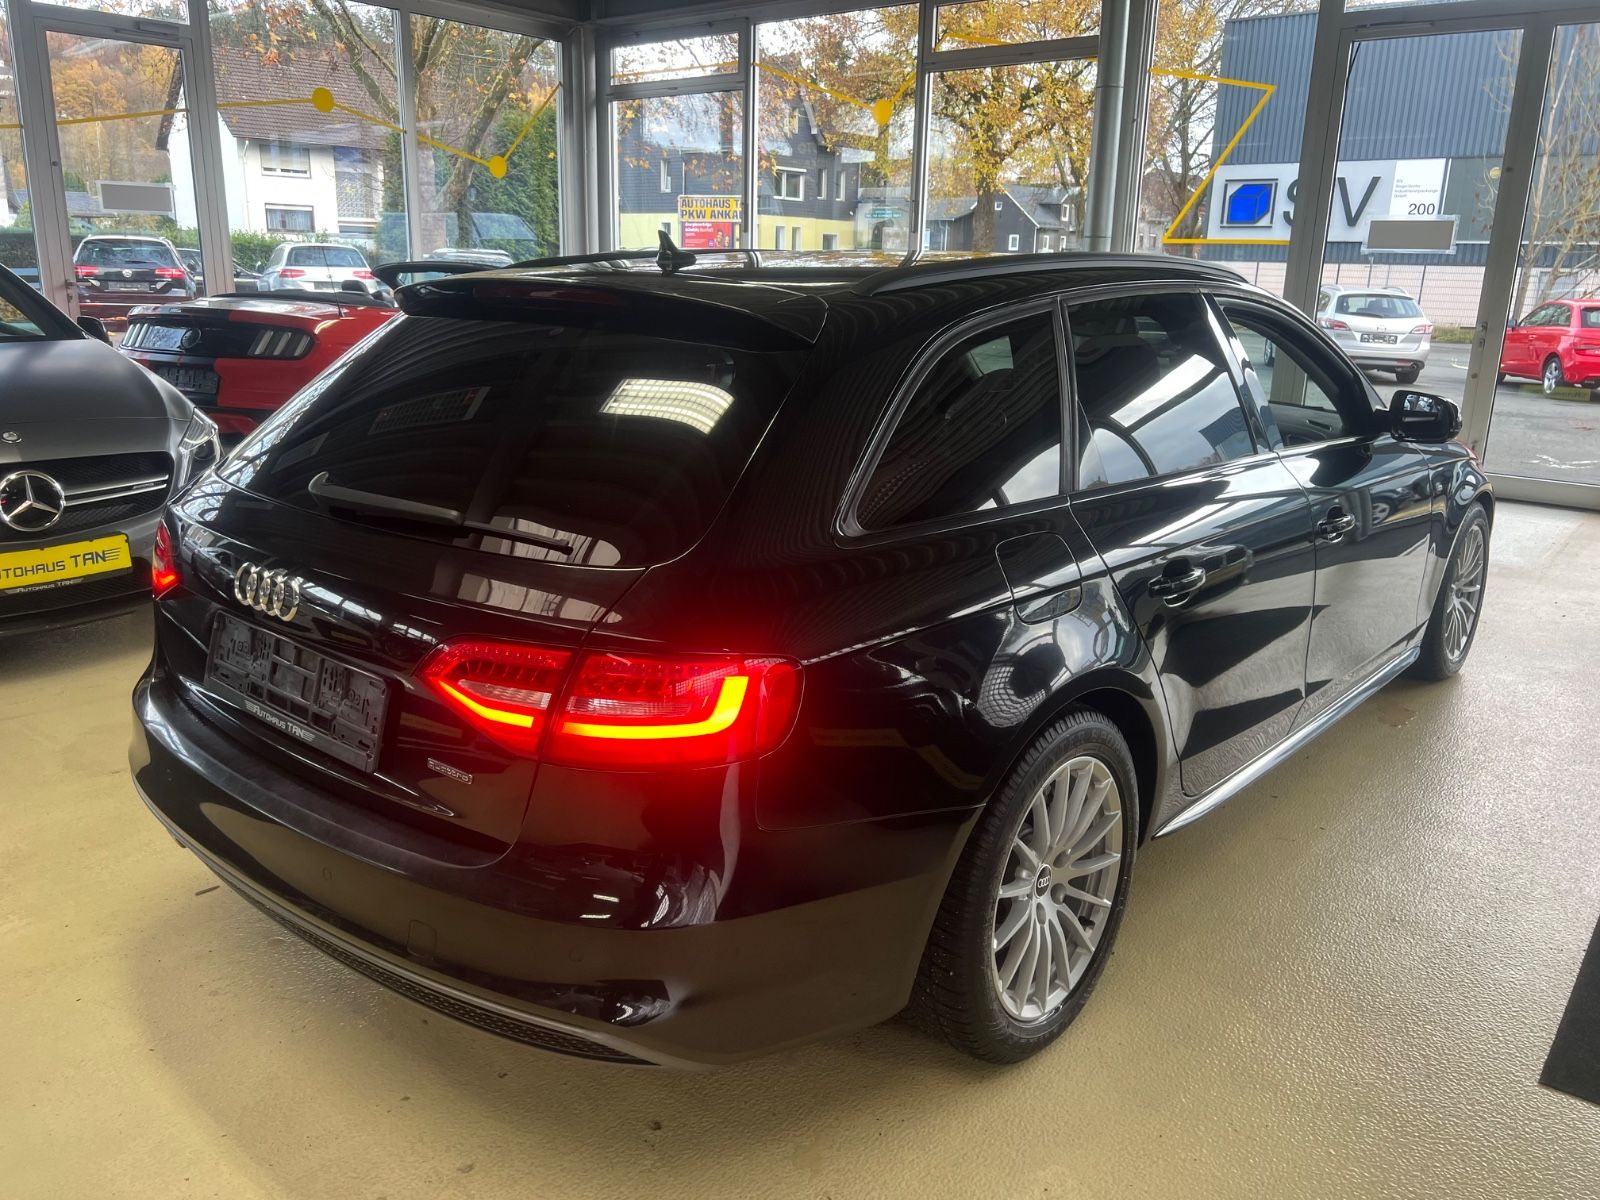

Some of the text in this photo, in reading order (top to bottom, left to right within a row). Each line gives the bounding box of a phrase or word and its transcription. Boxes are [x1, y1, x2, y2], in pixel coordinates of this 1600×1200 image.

[681, 199, 731, 208] AUTOHAUS
[1408, 203, 1436, 215] 200
[681, 210, 742, 219] PKW ANKA
[0, 560, 66, 580] TOHAUS
[253, 705, 286, 729] AUTOHAUS
